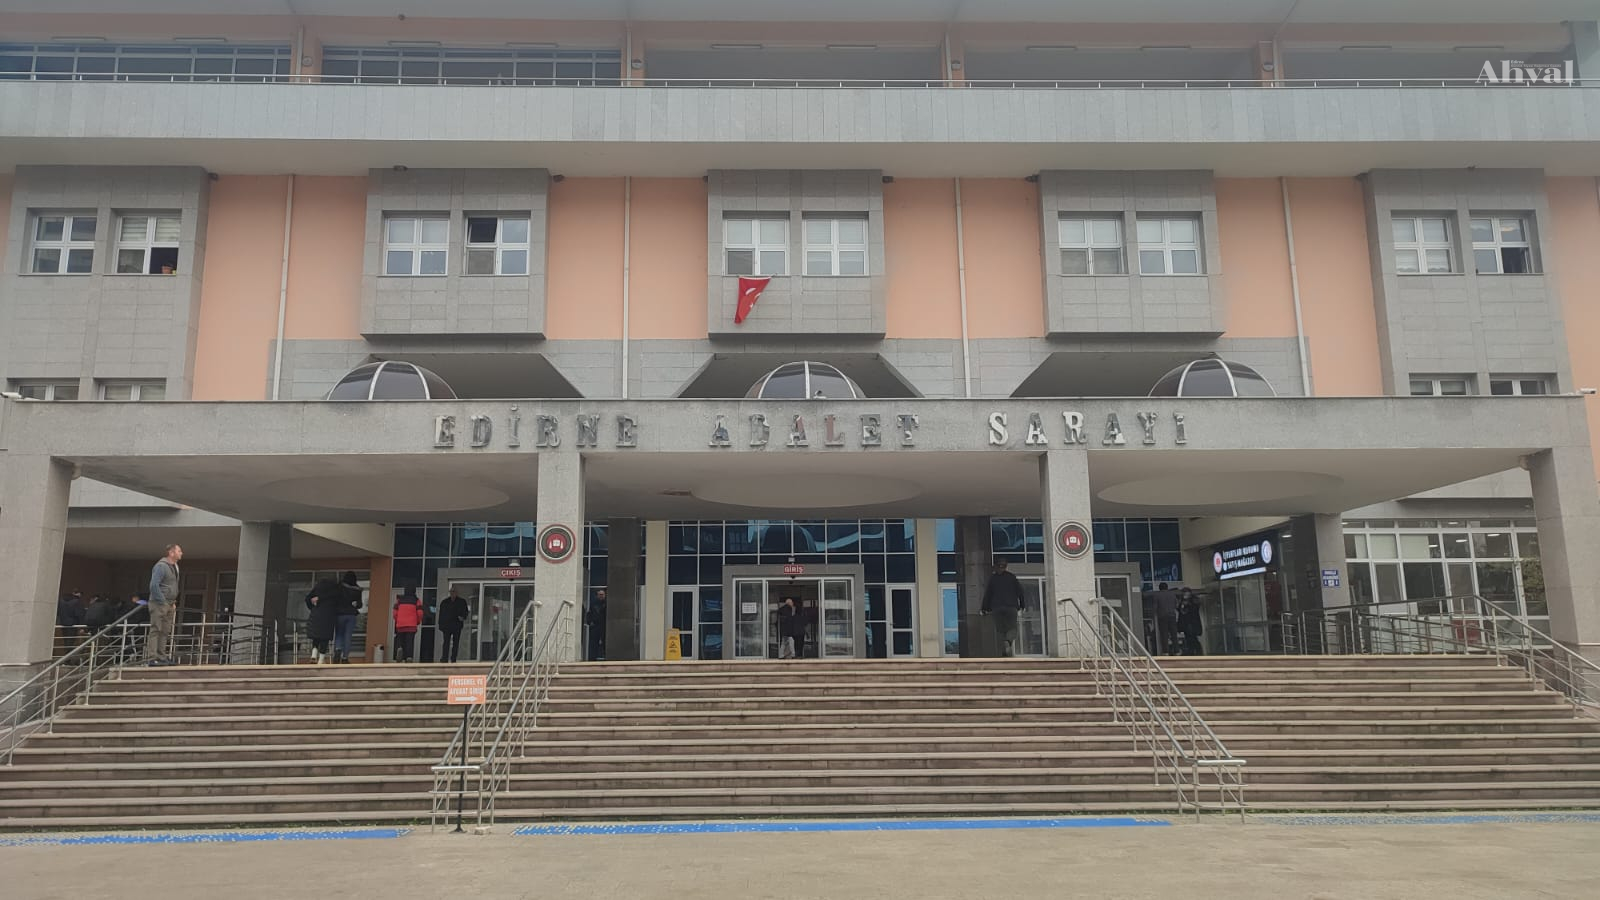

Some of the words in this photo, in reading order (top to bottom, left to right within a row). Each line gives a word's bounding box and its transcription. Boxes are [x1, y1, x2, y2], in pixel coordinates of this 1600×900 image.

[433, 404, 638, 447] EDİRNE
[708, 413, 920, 447] ADALET
[501, 569, 521, 577] ÇIKIŞ
[784, 564, 804, 574] GİRİŞ
